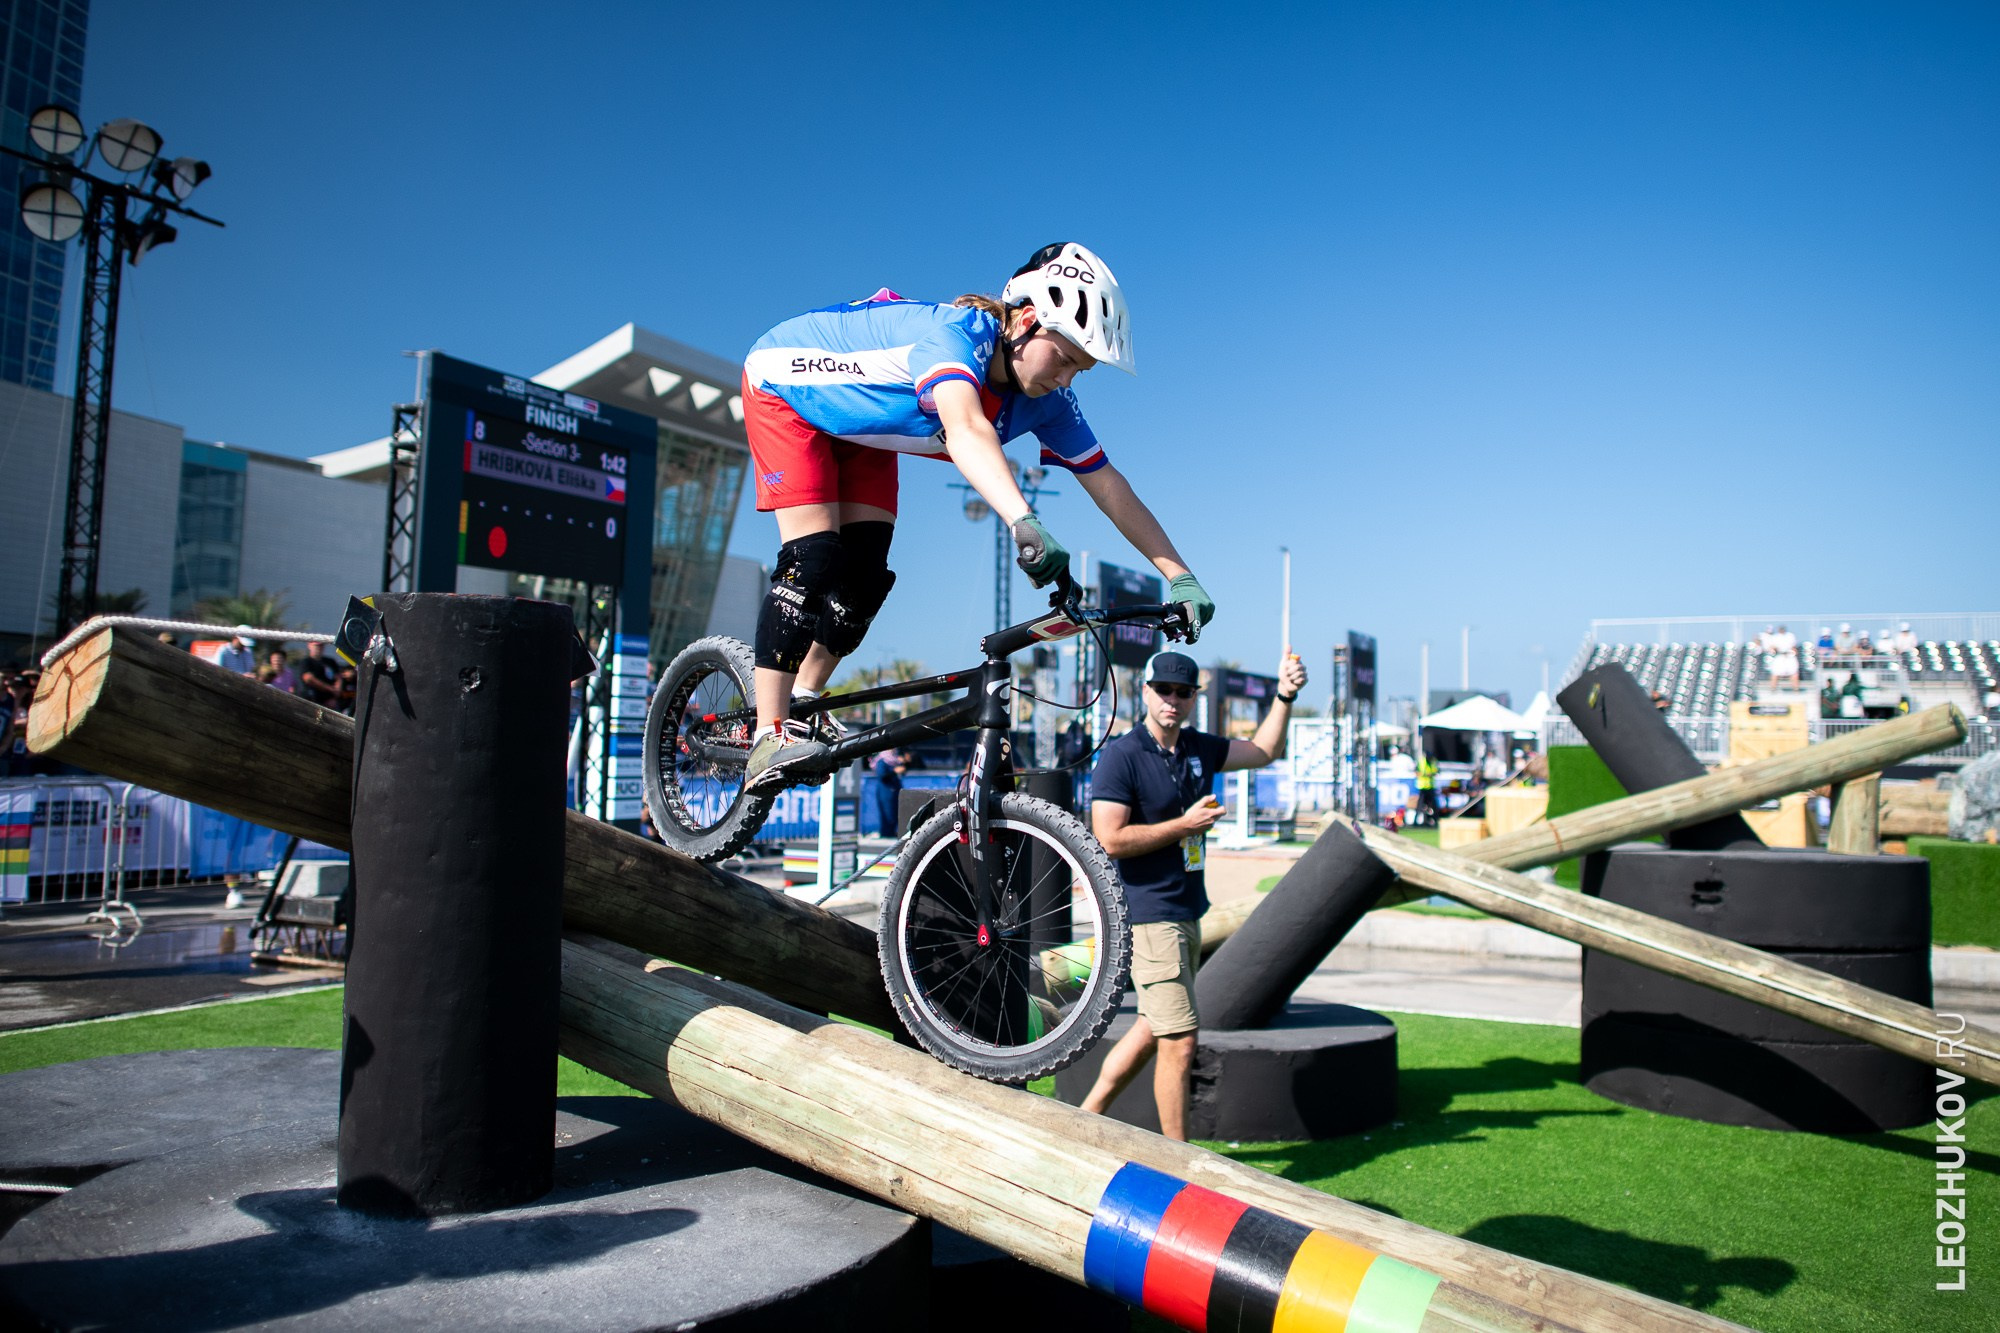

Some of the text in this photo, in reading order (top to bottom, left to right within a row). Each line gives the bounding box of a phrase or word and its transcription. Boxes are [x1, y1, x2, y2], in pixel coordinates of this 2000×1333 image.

[1046, 264, 1095, 284] POC
[475, 420, 485, 440] 8
[526, 404, 578, 435] FINISH
[600, 452, 627, 475] 1:42
[772, 585, 806, 606] JITSIE
